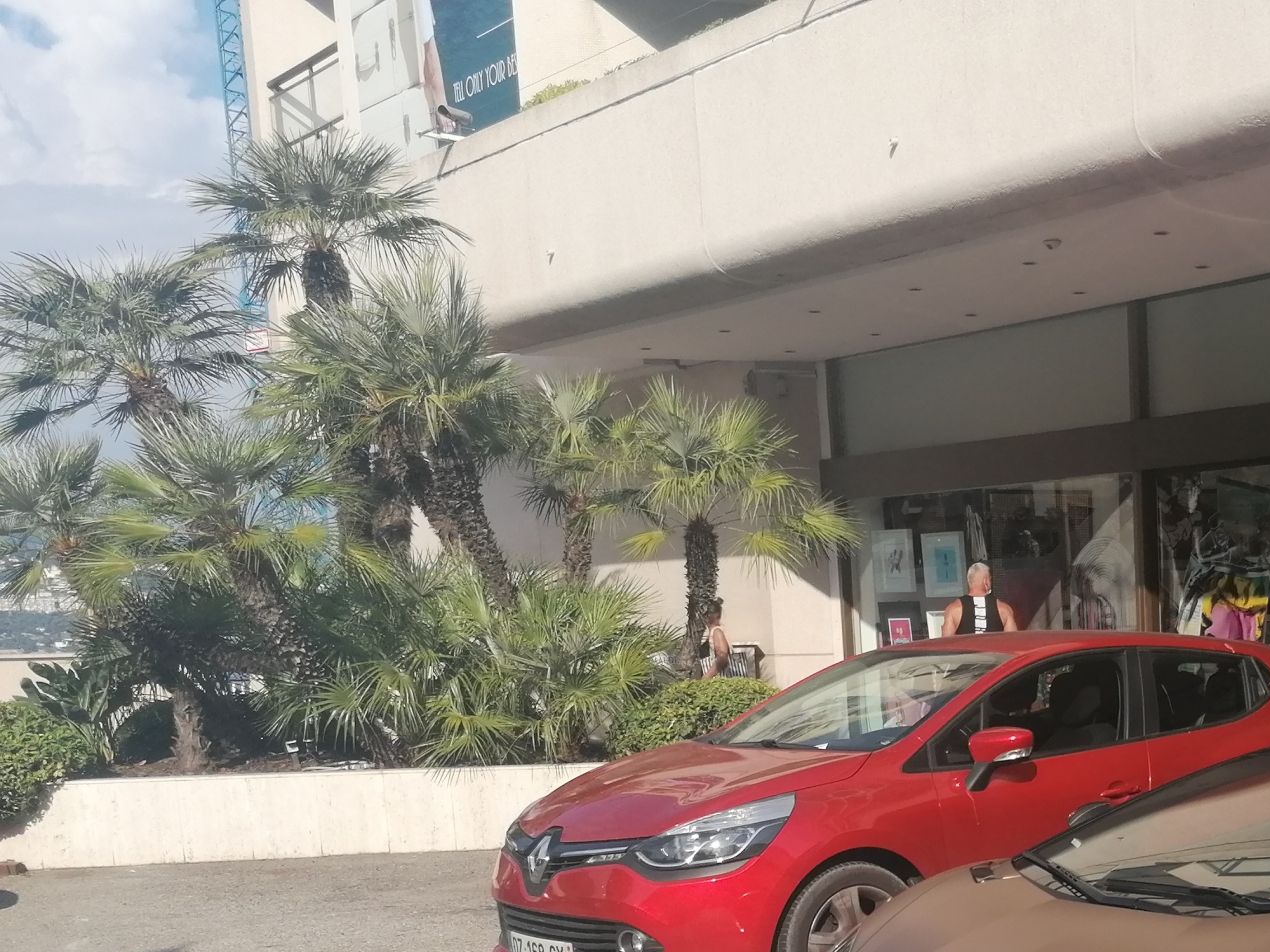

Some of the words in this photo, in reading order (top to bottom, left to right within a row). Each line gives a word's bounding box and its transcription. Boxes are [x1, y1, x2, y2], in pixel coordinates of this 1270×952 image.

[453, 80, 465, 104] TELL
[465, 69, 484, 97] ONLY
[484, 60, 506, 88] YOUR
